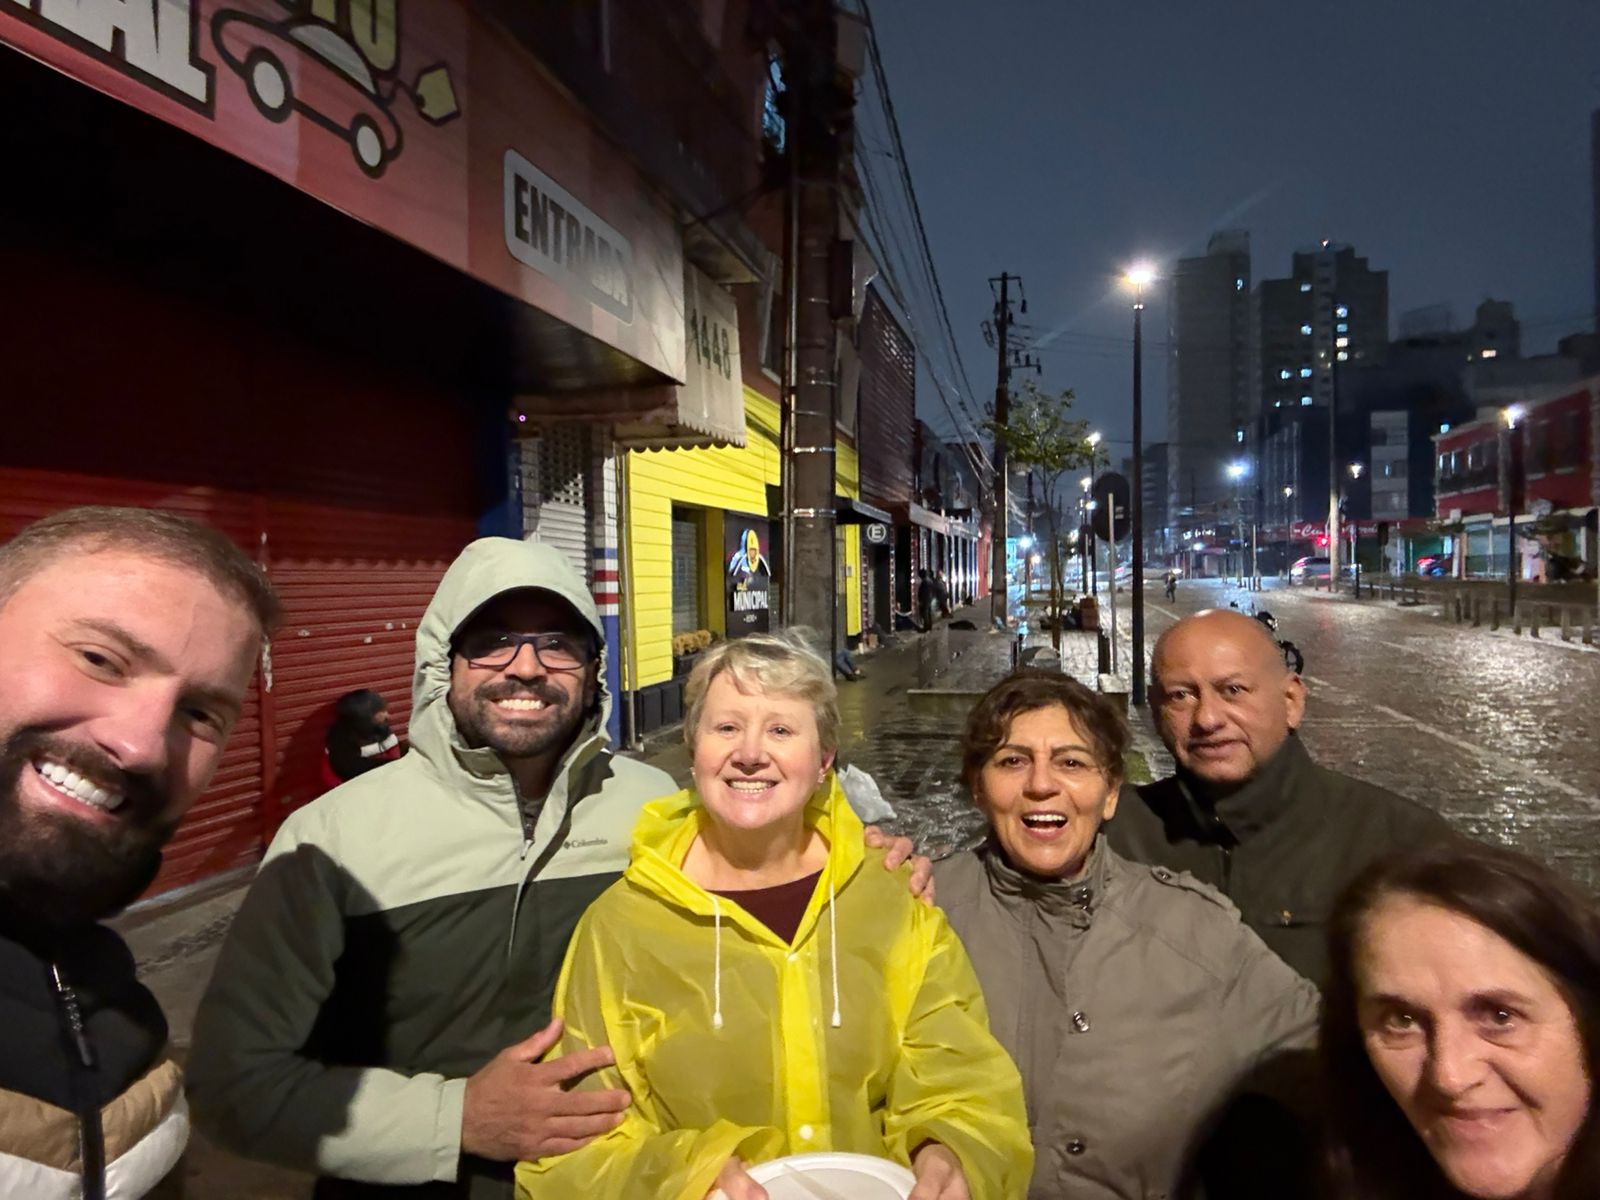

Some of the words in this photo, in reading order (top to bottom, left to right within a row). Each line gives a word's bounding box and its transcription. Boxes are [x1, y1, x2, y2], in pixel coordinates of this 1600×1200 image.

[513, 171, 629, 307] ENTRADA
[690, 309, 732, 381] 1448
[871, 525, 882, 539] E
[733, 590, 769, 611] MUNICIPAL
